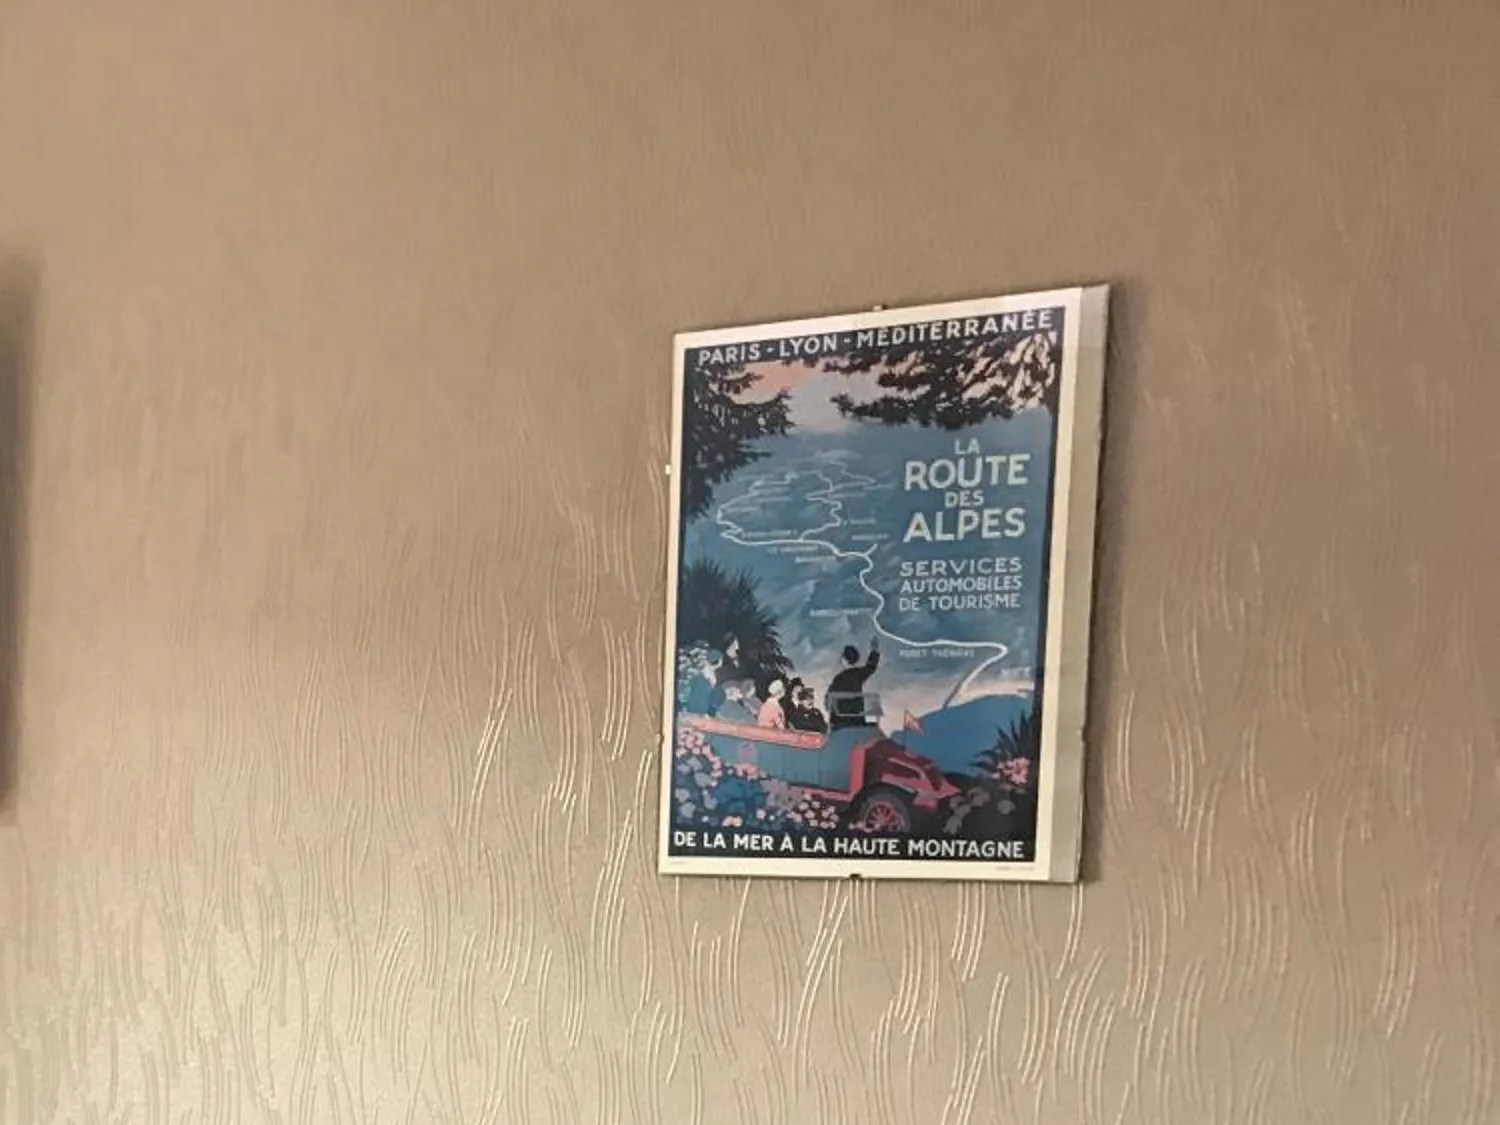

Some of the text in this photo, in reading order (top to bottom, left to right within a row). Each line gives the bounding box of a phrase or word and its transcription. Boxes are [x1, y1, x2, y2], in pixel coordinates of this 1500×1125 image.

[698, 342, 761, 366] PARIS
[779, 333, 837, 357] LYON
[954, 436, 980, 455] LA
[903, 453, 1031, 491] ROUTE
[944, 489, 985, 509] DES
[902, 507, 1027, 543] ALPES
[899, 556, 1023, 577] SERVICES
[899, 575, 1023, 594] AUTOMOBILES
[898, 593, 1022, 612] DE TOURISME
[673, 830, 697, 847] DE
[703, 832, 726, 849] LA
[732, 834, 774, 851] MER
[801, 836, 827, 853] LA
[833, 837, 900, 856] HAUTE
[907, 839, 1025, 858] MONTAGNE
